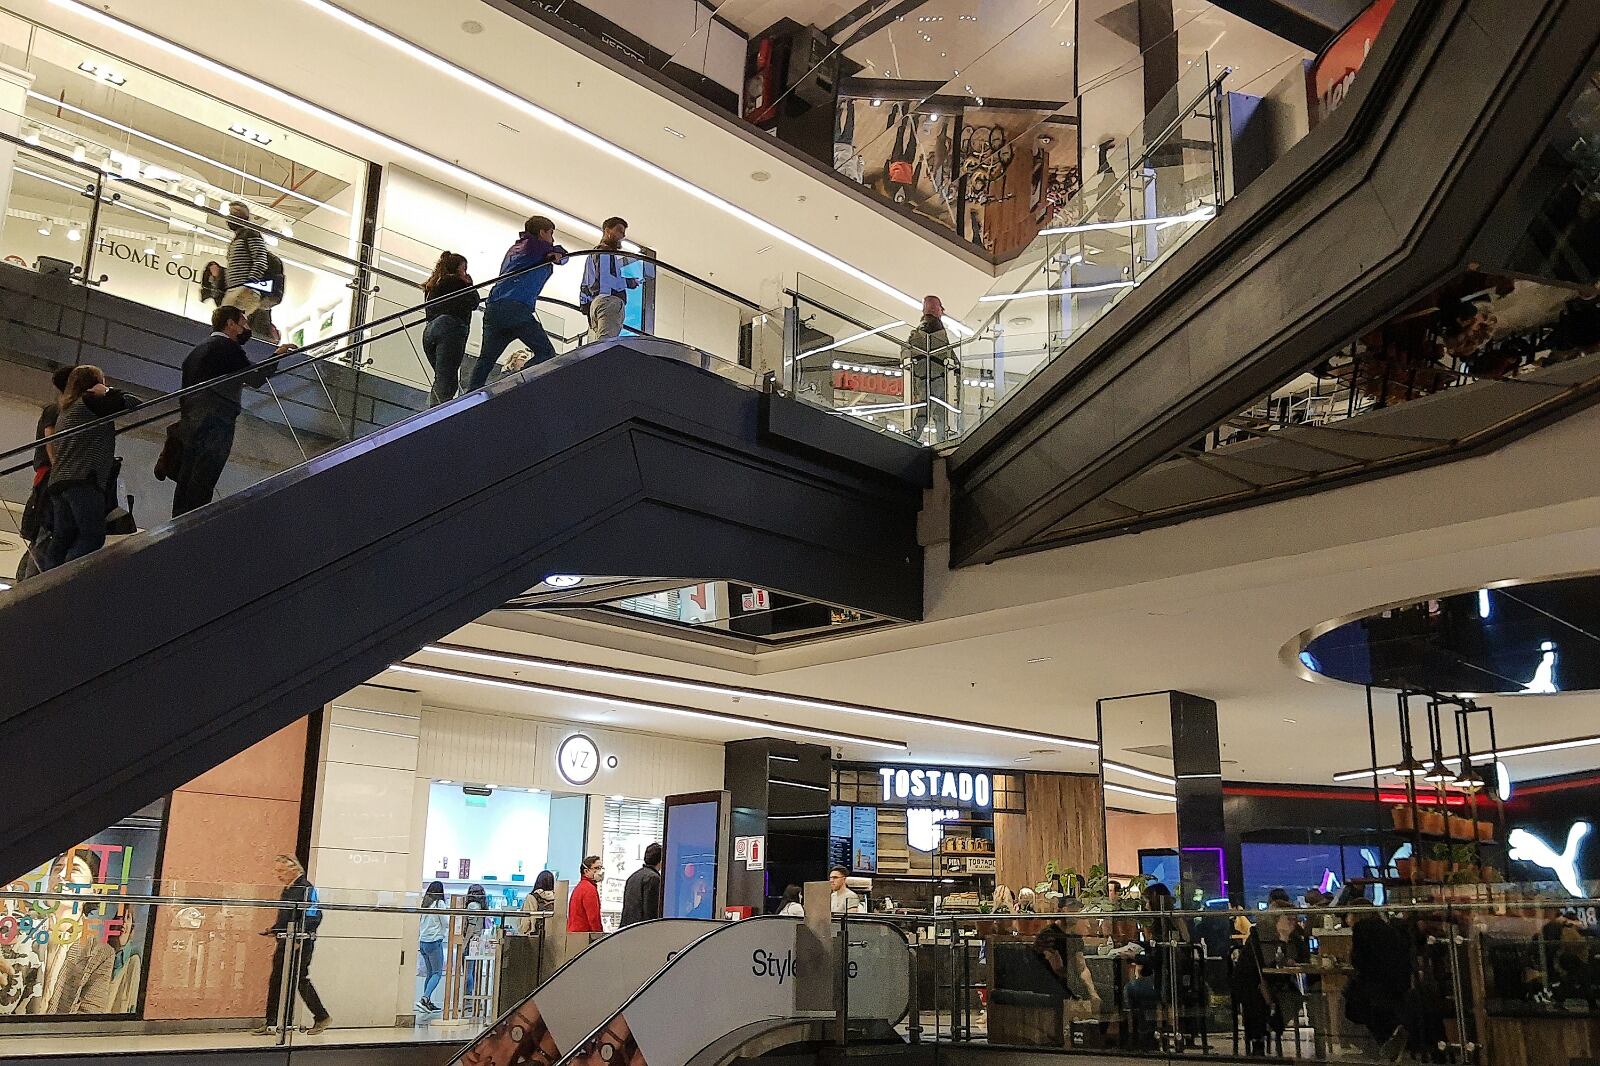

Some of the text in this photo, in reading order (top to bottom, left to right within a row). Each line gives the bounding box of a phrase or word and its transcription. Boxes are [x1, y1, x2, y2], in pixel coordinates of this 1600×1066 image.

[98, 238, 160, 270] HOME
[570, 751, 589, 769] VZ
[879, 768, 990, 807] TOSTADO
[52, 917, 124, 946] OFF
